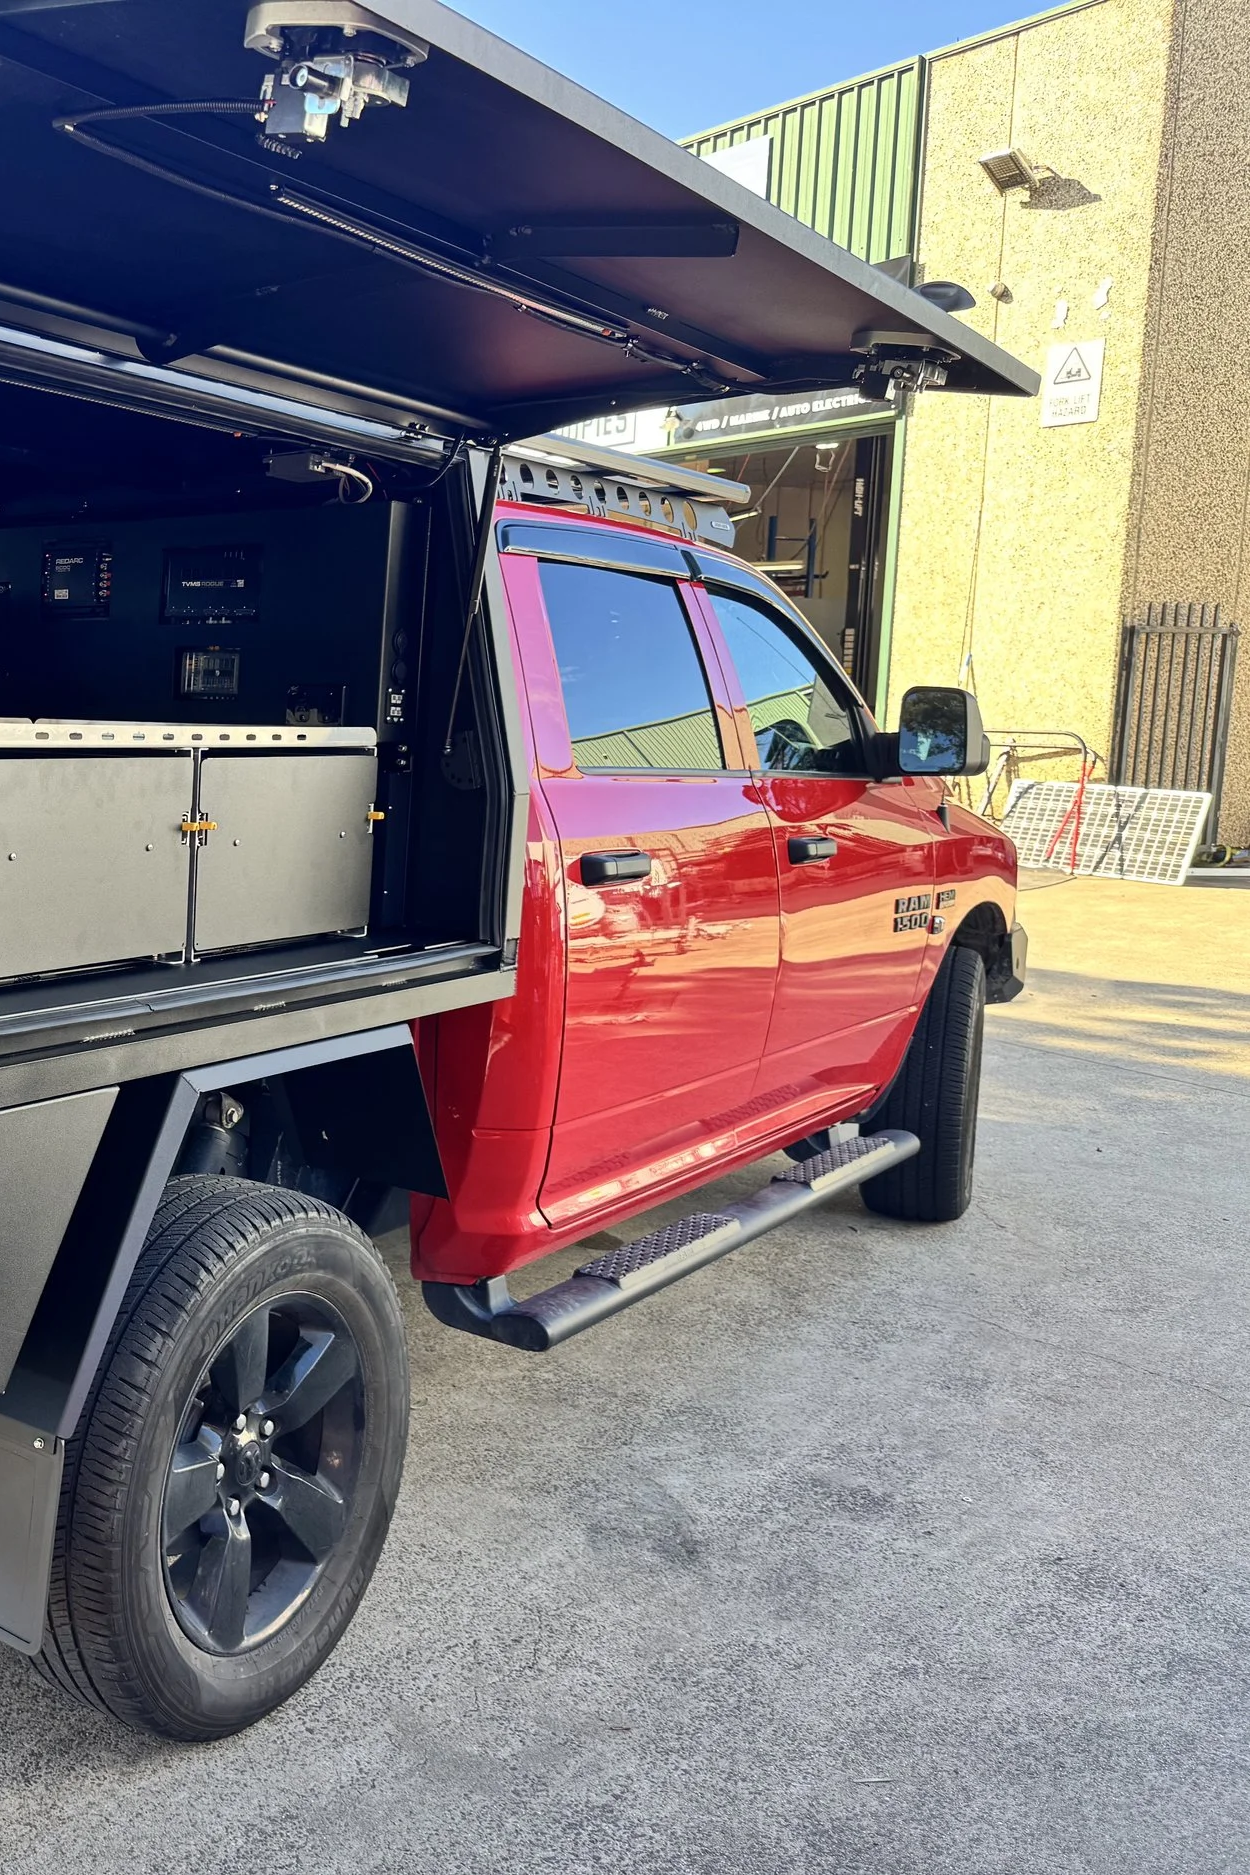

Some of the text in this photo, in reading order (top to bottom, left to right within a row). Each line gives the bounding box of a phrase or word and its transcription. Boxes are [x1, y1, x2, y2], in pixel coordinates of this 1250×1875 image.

[1073, 394, 1090, 405] LIFT
[695, 418, 720, 432] 4WD
[779, 401, 811, 419] AUTO
[896, 894, 931, 914] RAM
[895, 912, 930, 932] 1500
